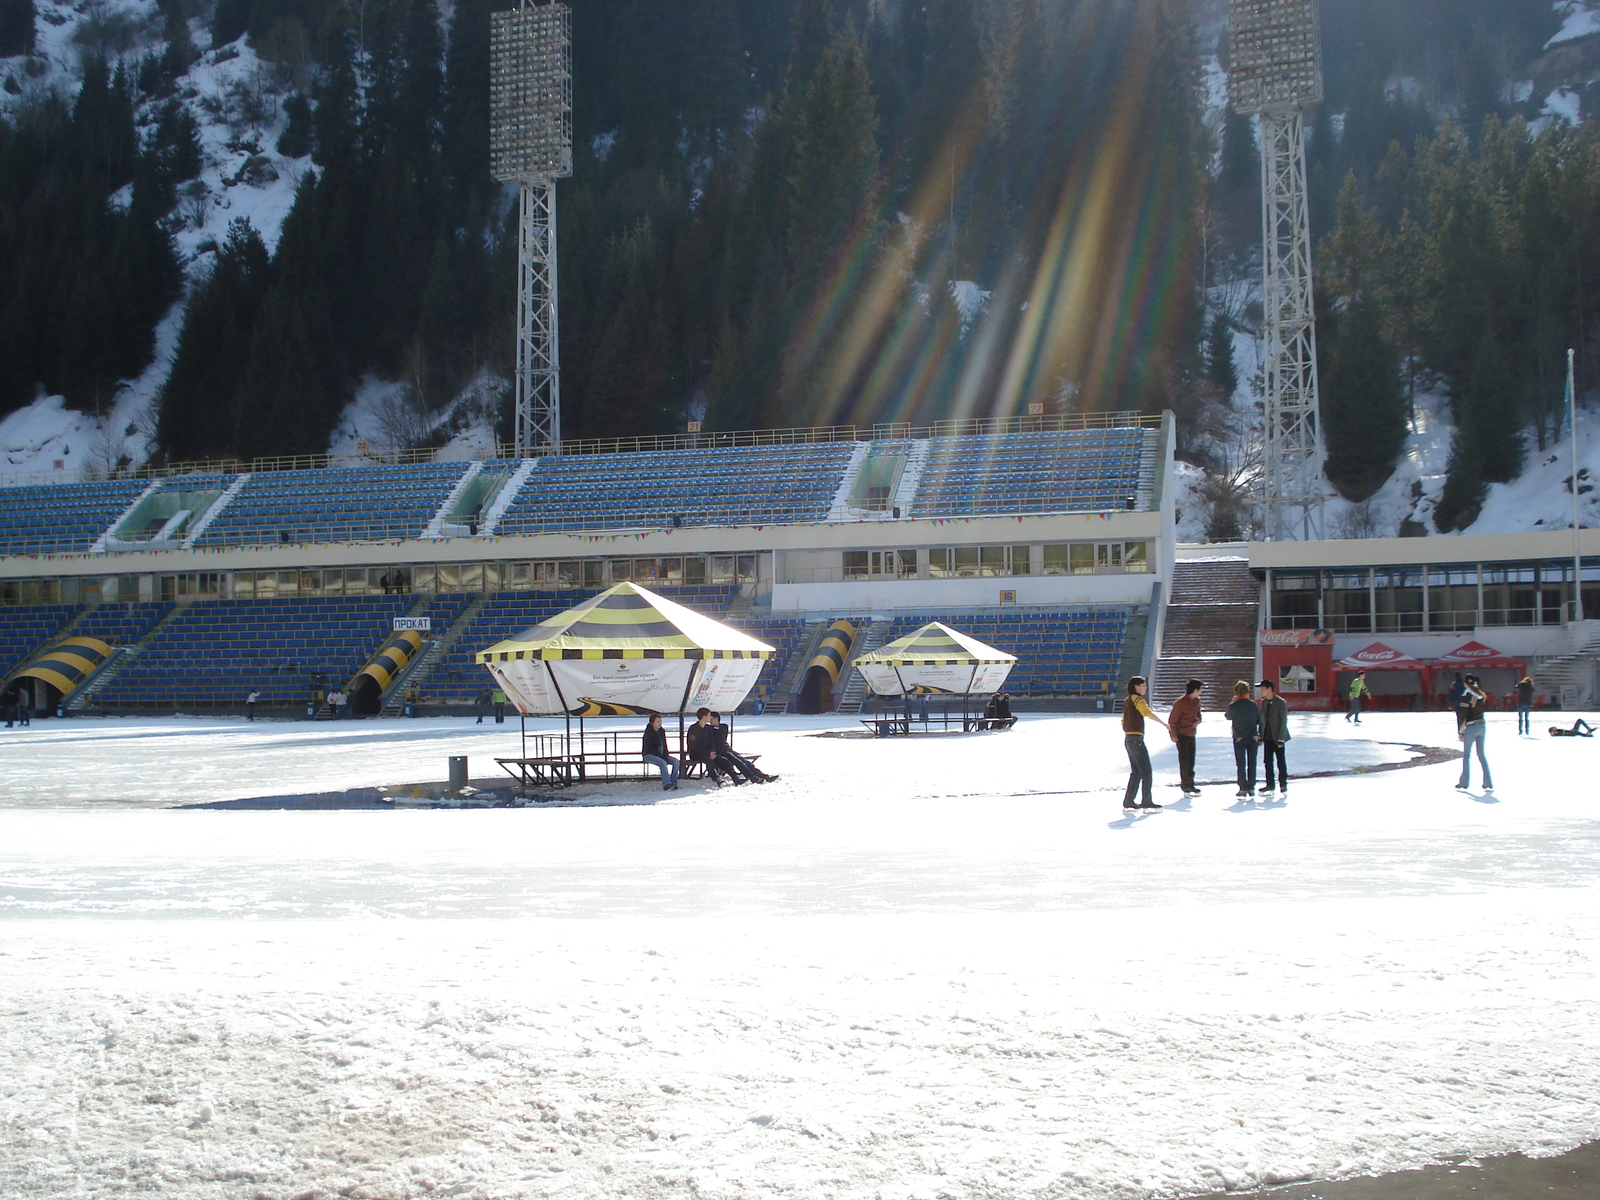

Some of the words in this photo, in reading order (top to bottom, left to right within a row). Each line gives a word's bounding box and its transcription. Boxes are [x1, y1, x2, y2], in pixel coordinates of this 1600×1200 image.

[1030, 404, 1042, 413] 22
[689, 422, 699, 431] 21
[357, 442, 367, 450] 20
[1003, 592, 1013, 601] 16
[394, 618, 429, 629] ПРОКАТ
[1264, 630, 1300, 644] Coca-Cola
[1357, 650, 1395, 659] Coca-Cola
